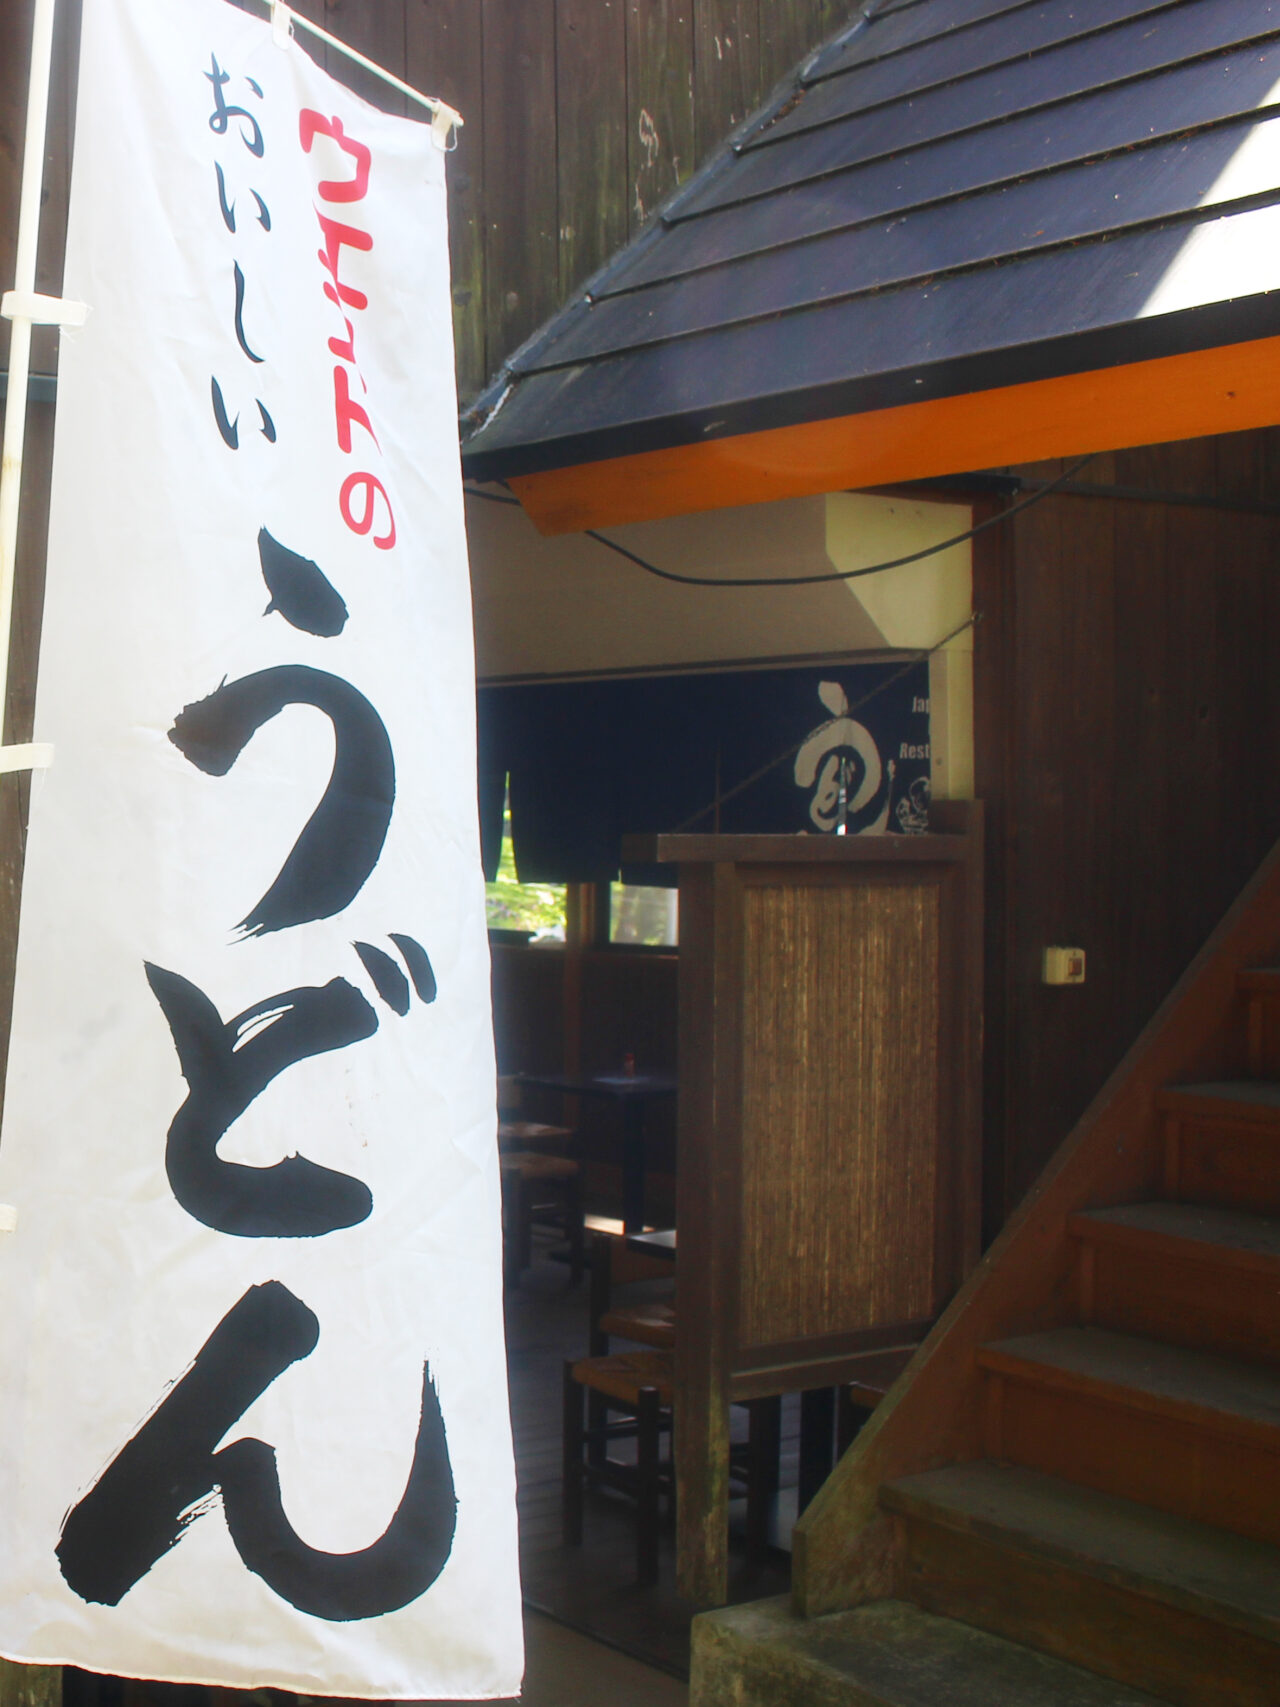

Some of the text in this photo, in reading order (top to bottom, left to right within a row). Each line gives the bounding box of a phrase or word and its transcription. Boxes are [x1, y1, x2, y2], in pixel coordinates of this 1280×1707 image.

[202, 51, 277, 451] おいしい
[56, 524, 459, 1623] うどん
